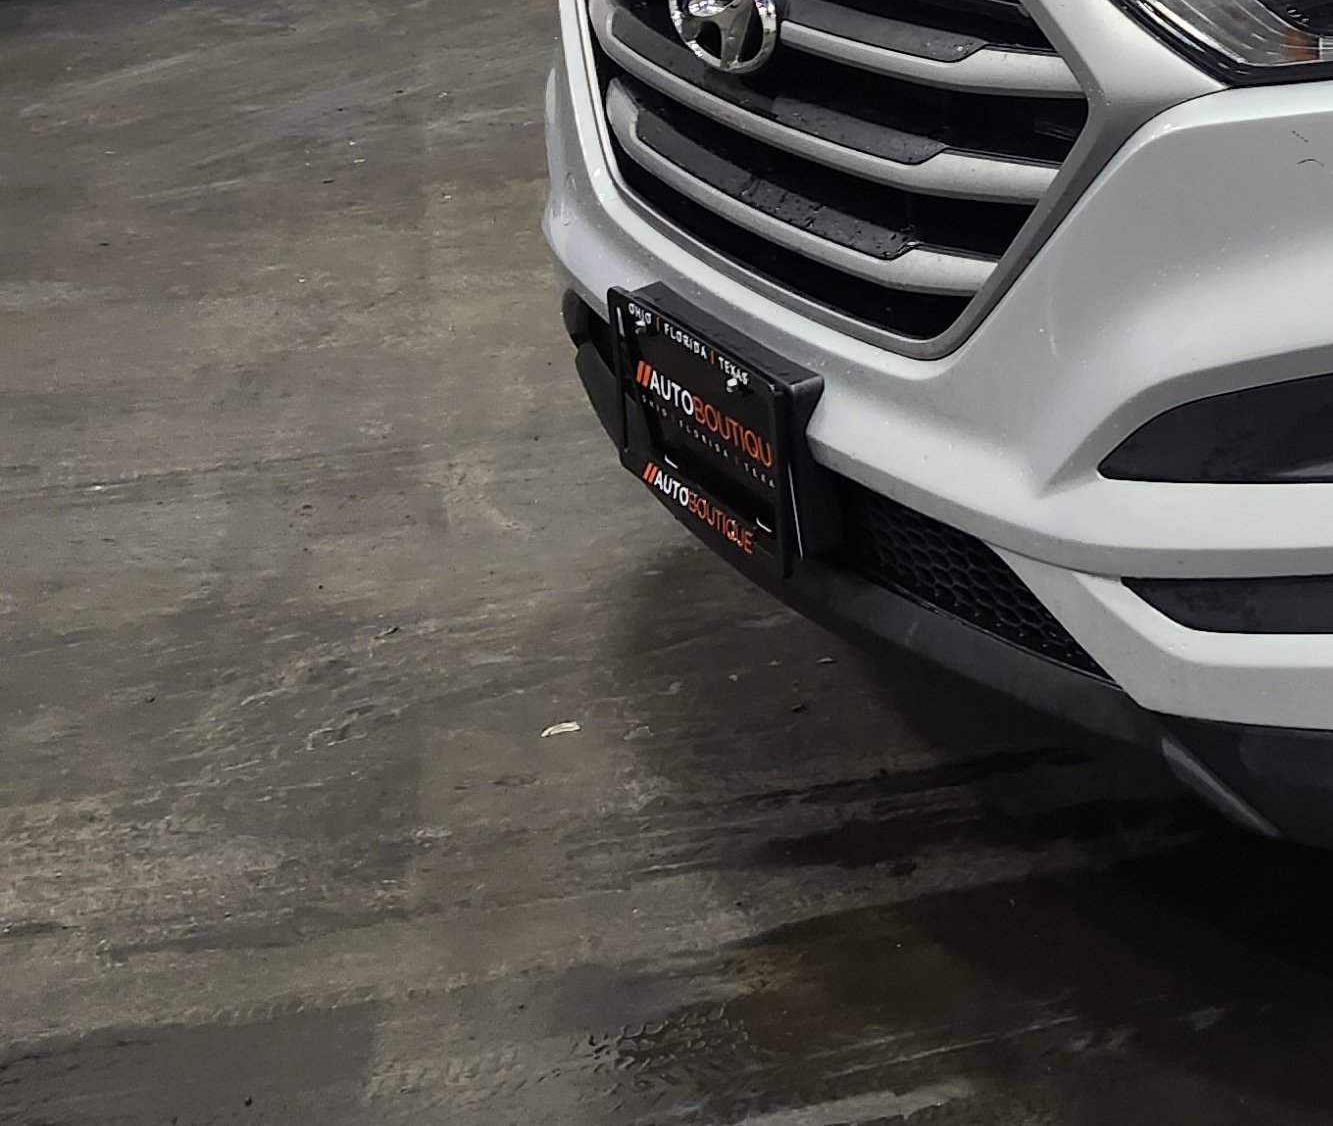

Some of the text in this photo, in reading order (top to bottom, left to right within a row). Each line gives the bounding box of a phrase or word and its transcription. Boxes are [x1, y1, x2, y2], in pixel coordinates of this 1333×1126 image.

[628, 302, 750, 386] OHIO FLORIDA TEXAS
[650, 369, 773, 468] AUTOBOUTIQU
[653, 470, 754, 555] AUTOBOUTIQUE
[743, 462, 776, 489] TEXA
